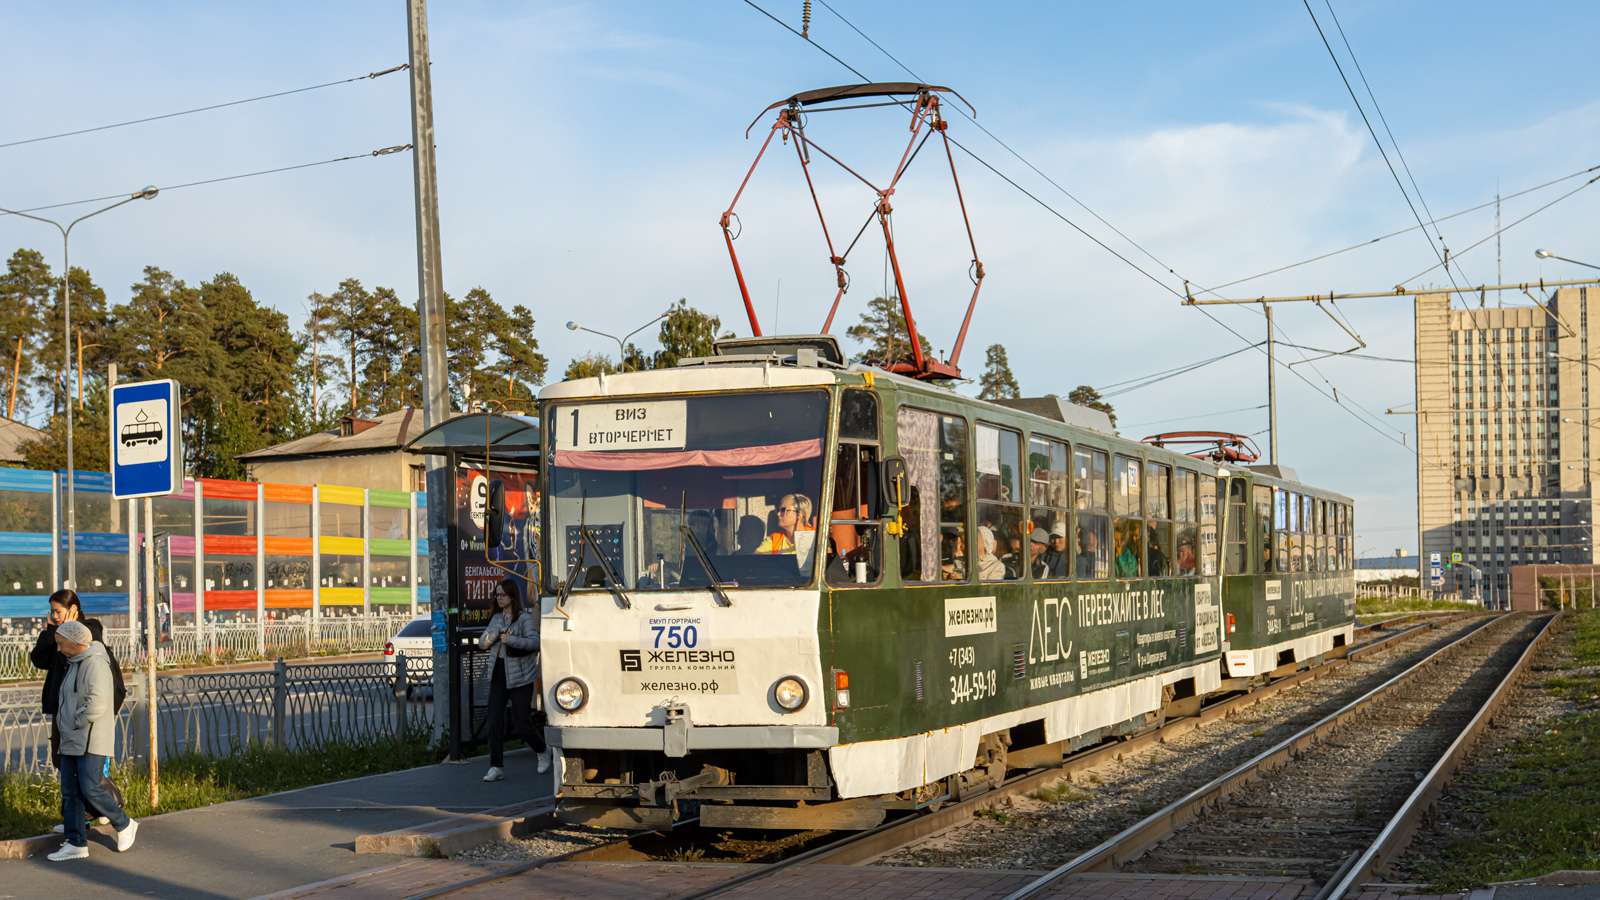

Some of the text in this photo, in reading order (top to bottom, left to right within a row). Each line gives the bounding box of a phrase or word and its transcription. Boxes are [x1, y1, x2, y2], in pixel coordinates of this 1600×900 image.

[615, 407, 647, 421] ВИЗ
[570, 409, 580, 447] 1
[589, 429, 673, 445] ВТОРЧЕРМЕТ
[460, 539, 469, 551] 0+
[465, 566, 505, 577] БЕНГАЛЬСКИЕ
[948, 602, 994, 628] железно.рф
[1078, 583, 1165, 628] ПЕРЕЕЗЖАЙТЕ В ЛЕС
[667, 617, 701, 625] ГОРТРАНС
[1028, 596, 1073, 665] ЛЕС
[650, 625, 698, 649] 750
[648, 650, 735, 663] ЖЕЛЕЗНО
[949, 646, 975, 668] +7 (343)
[640, 679, 719, 693] железно.рф
[949, 669, 997, 705] 344-59-18
[1030, 676, 1049, 690] живые
[1049, 670, 1075, 689] кварталы
